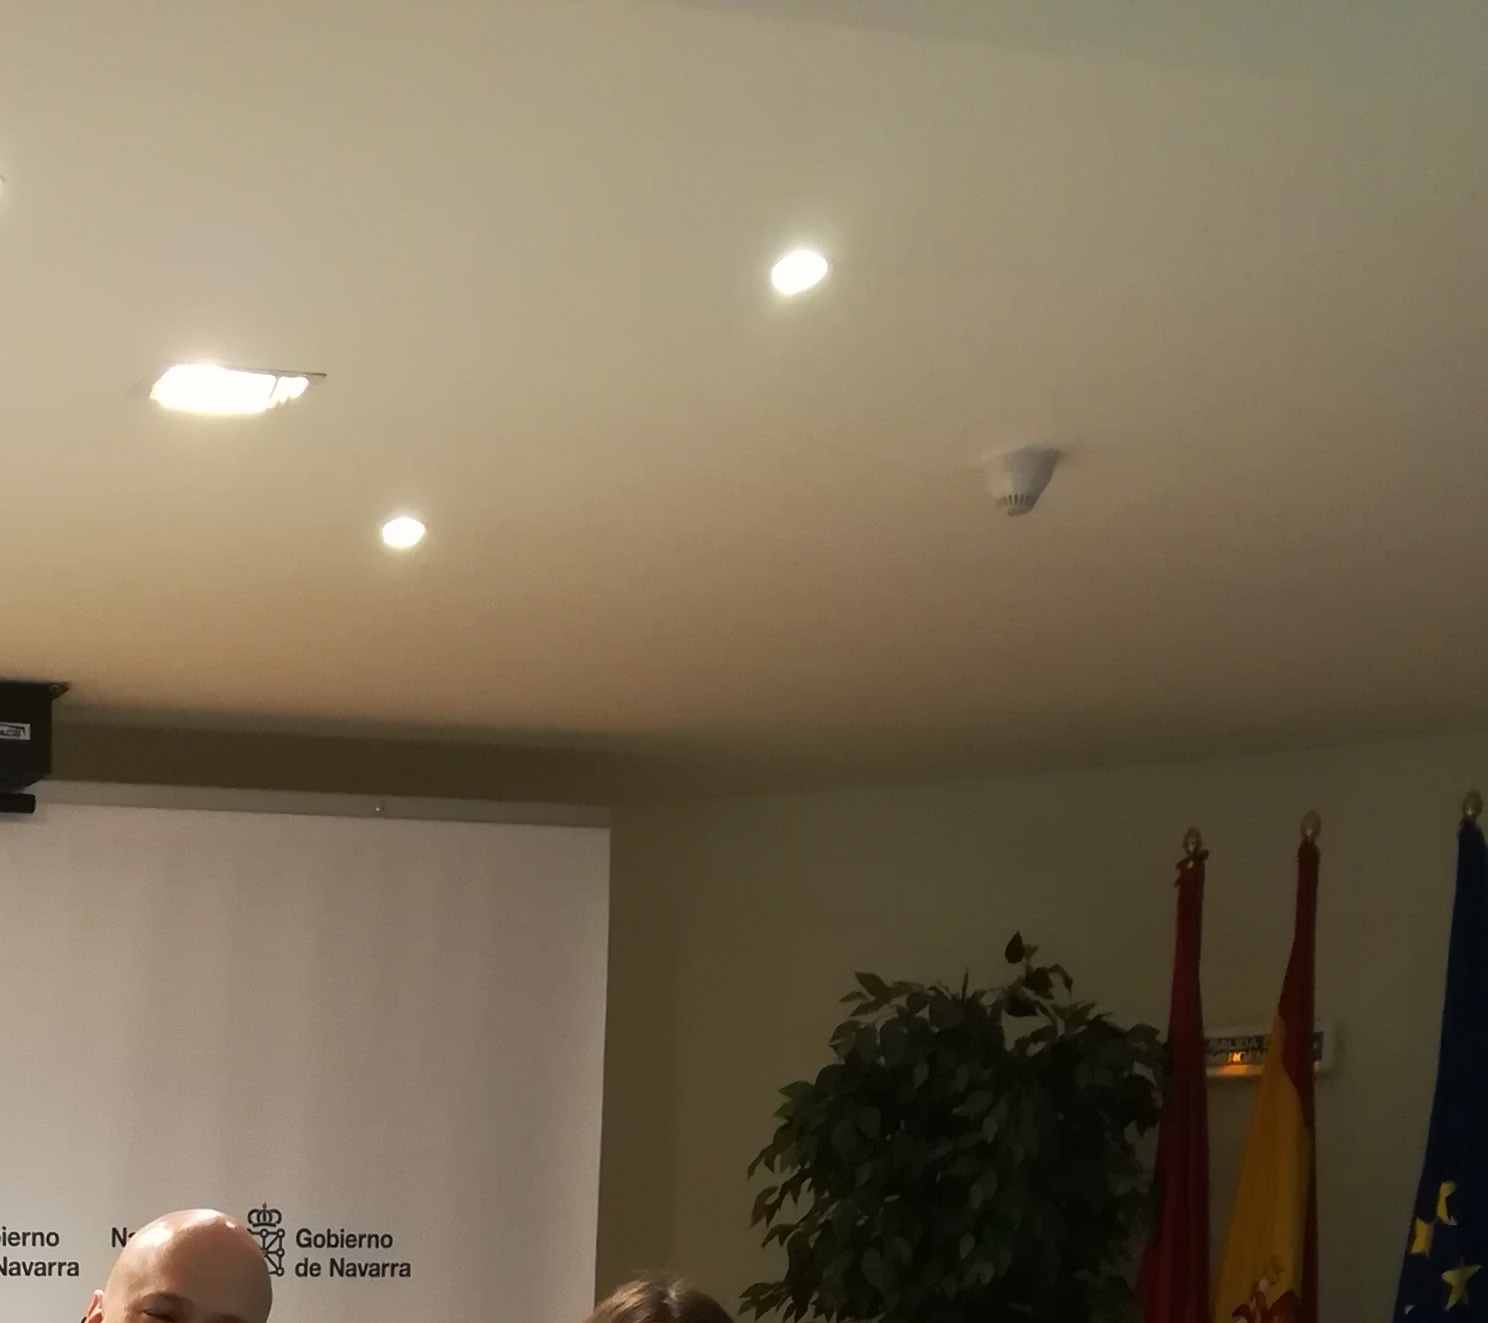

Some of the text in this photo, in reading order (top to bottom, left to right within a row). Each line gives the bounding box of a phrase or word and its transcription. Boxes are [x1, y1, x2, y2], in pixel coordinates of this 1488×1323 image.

[295, 1227, 394, 1250] Gobierno
[294, 1256, 412, 1279] de Navarra
